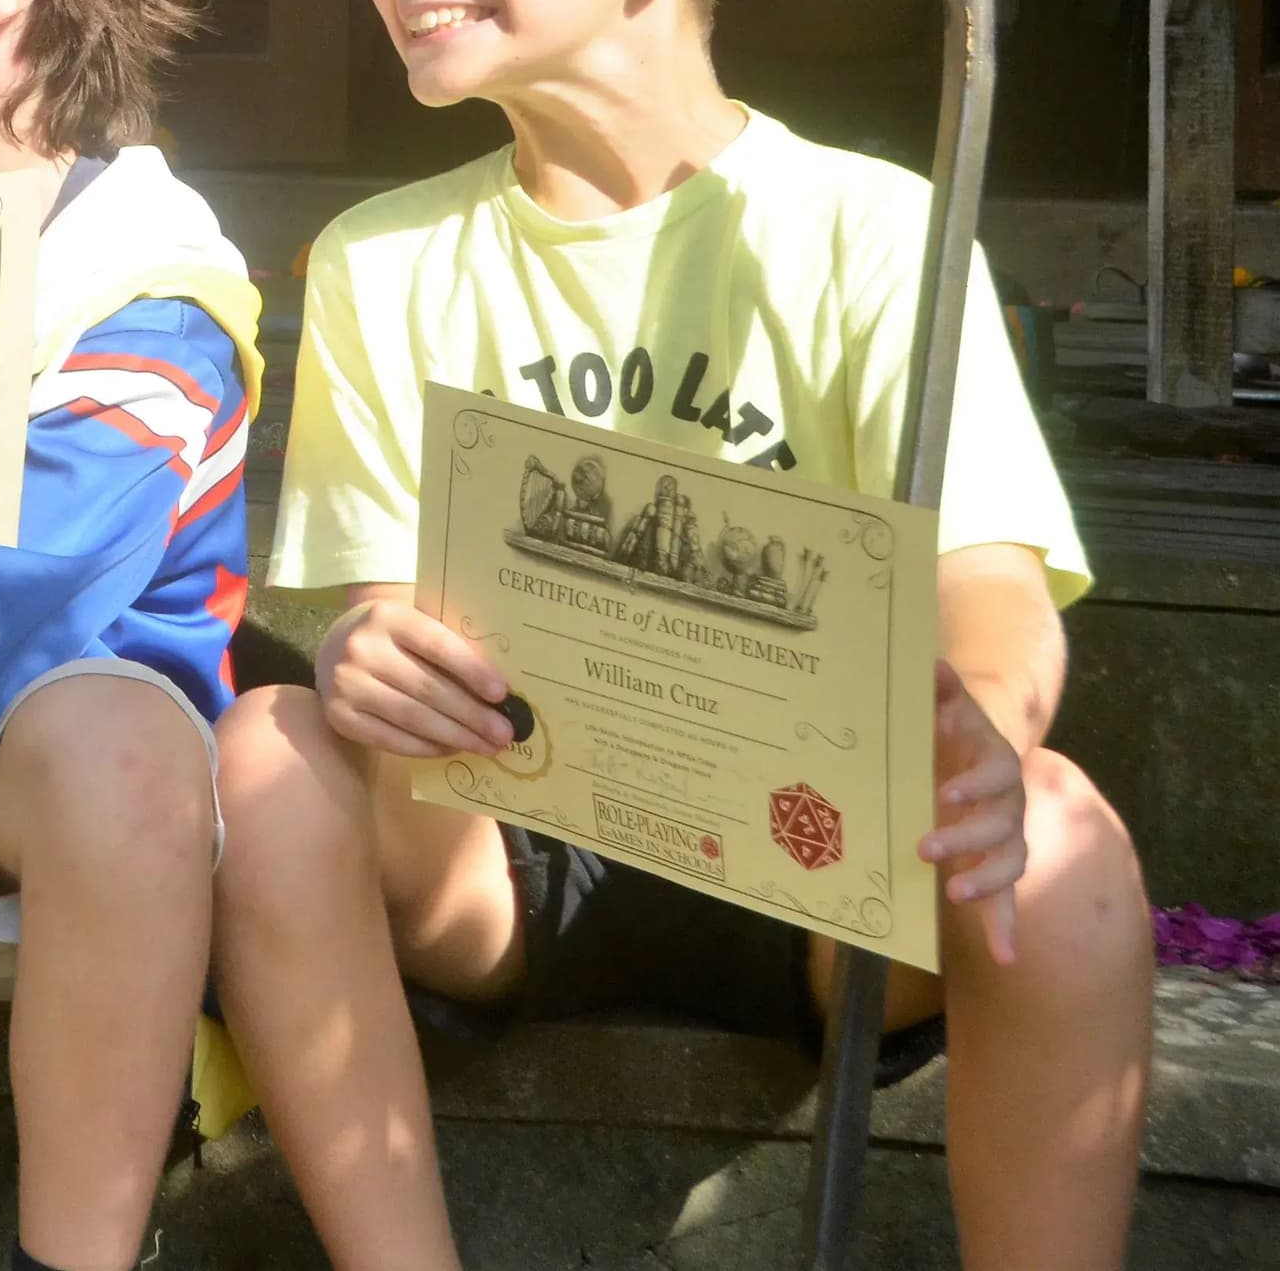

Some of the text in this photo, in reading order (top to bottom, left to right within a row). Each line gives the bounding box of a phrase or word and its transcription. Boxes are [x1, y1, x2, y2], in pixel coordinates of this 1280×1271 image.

[519, 346, 654, 418] TOO
[498, 567, 821, 675] CERTIFICATE of ACHIEVEMENT
[584, 657, 719, 715] William Cruz
